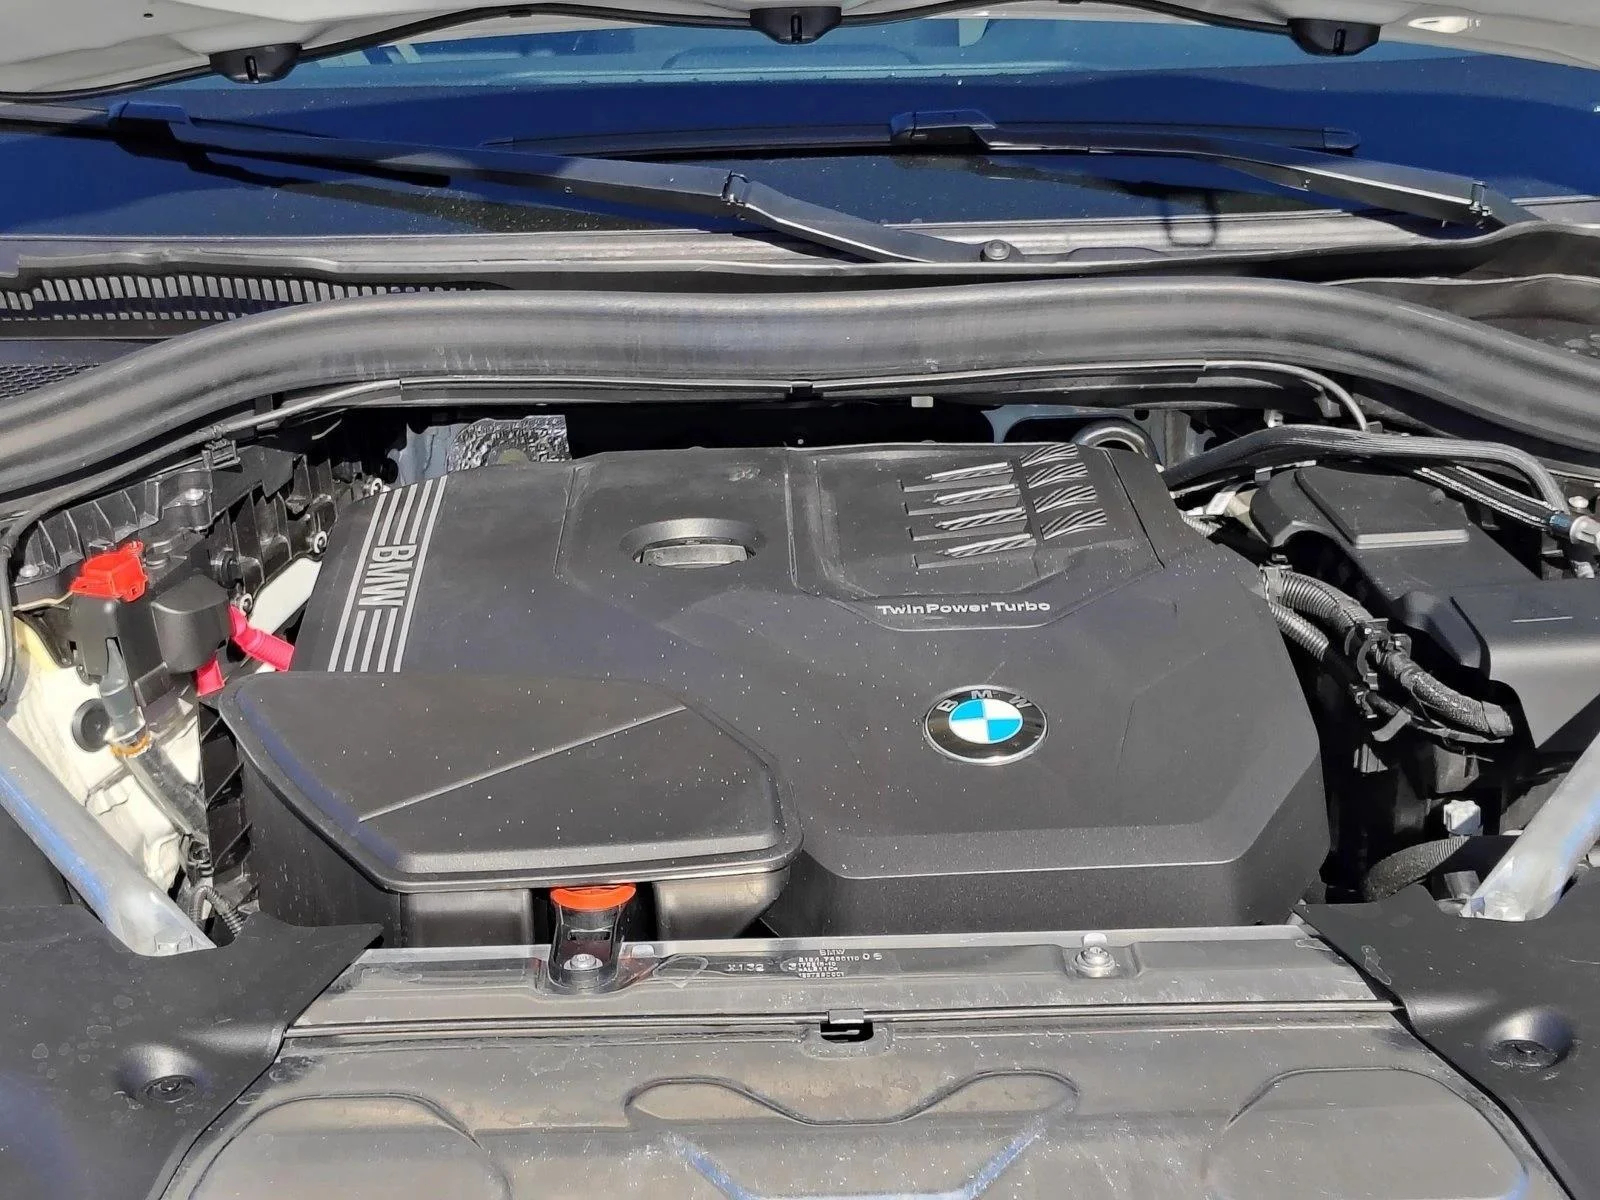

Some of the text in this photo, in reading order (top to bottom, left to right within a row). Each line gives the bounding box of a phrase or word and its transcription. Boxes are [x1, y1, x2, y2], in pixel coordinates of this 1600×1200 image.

[358, 544, 418, 606] BMW
[876, 601, 1051, 615] TwinPower Turbo
[936, 689, 1033, 713] BMW
